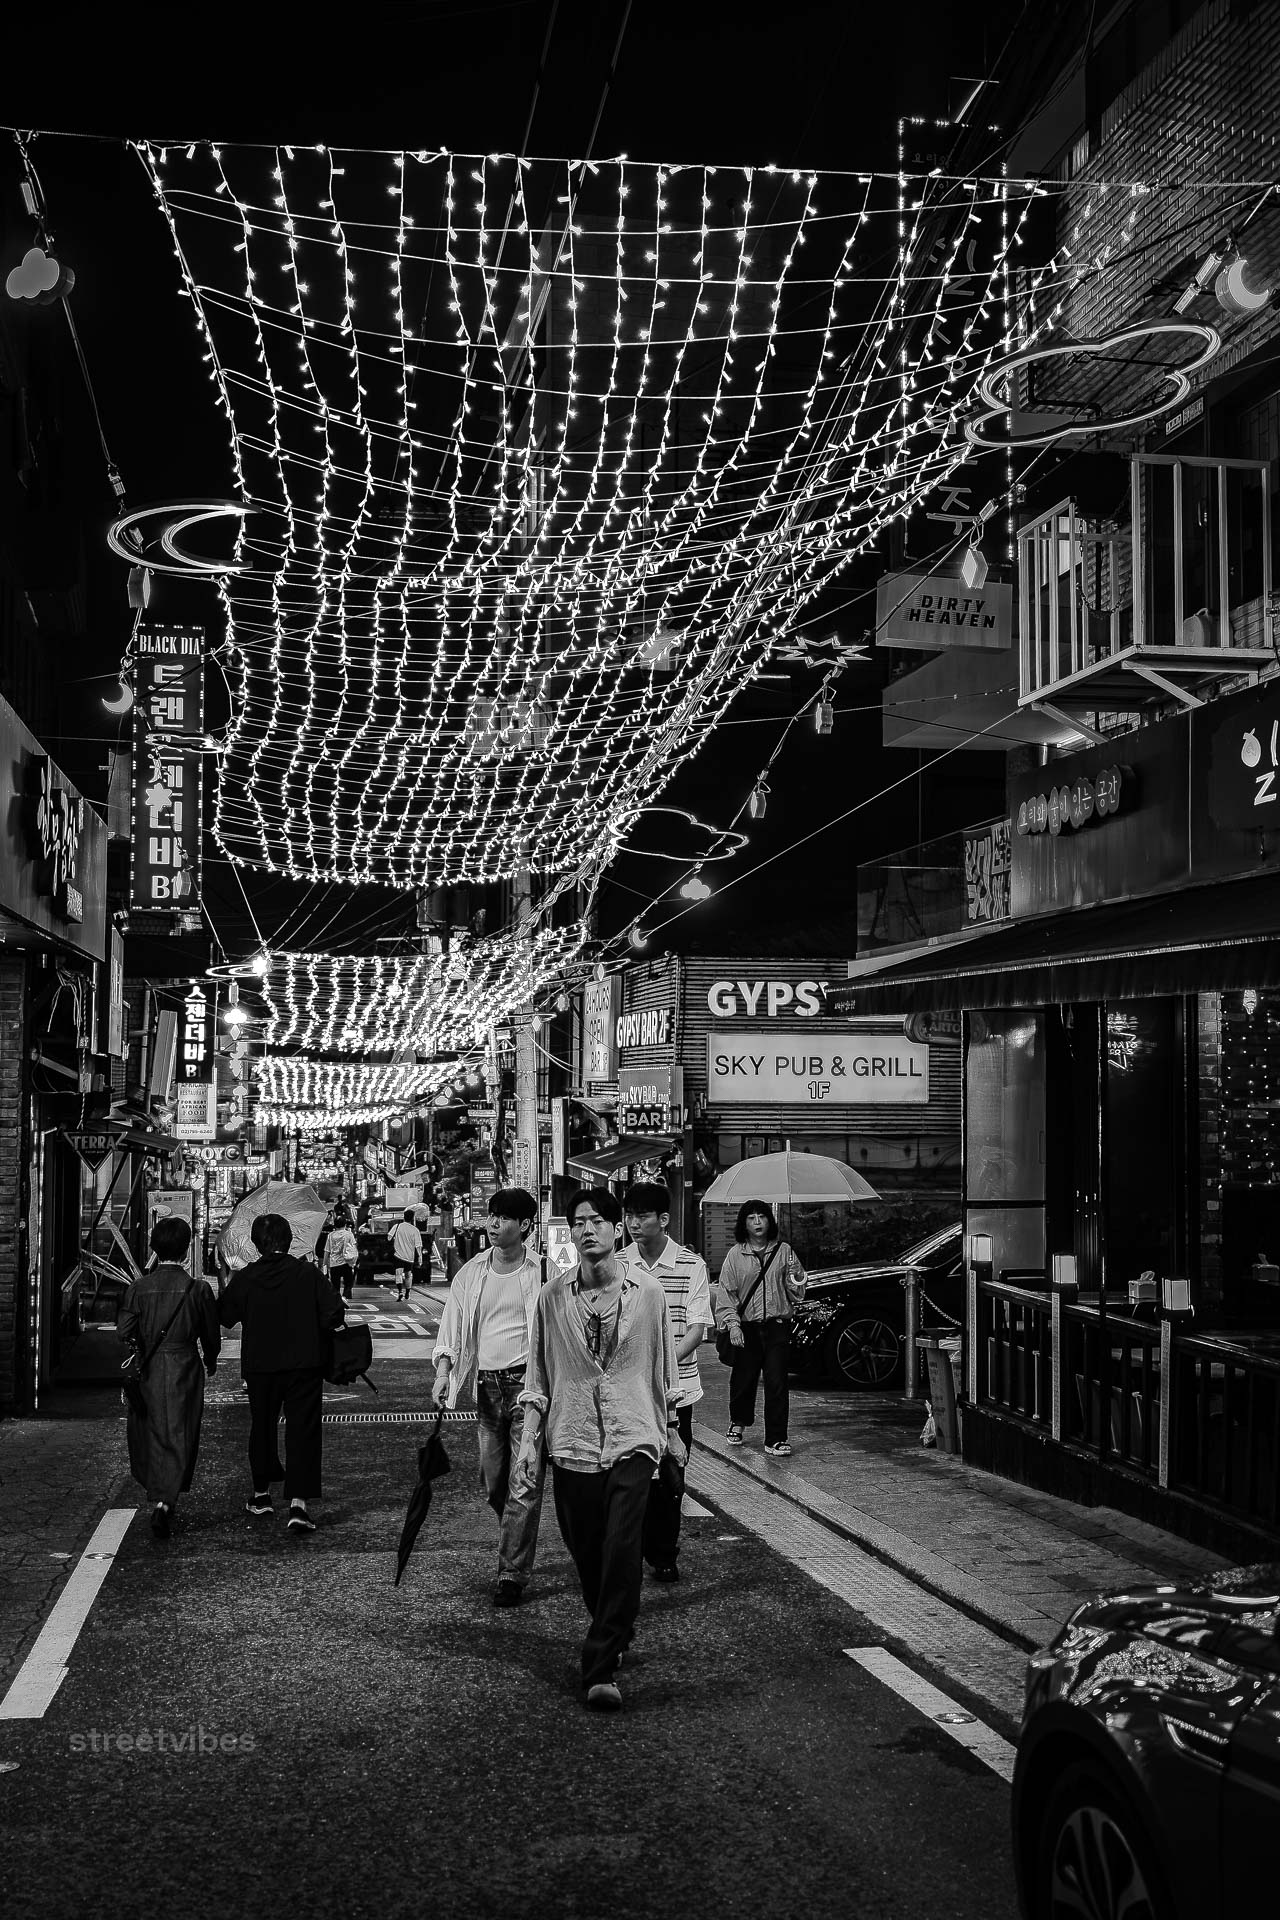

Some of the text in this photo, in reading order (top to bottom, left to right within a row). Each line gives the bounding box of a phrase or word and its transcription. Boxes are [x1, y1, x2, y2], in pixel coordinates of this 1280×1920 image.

[921, 594, 985, 612] DIRTY
[908, 608, 996, 629] HEAVEN
[139, 635, 200, 655] BLACK DIA
[1072, 786, 1092, 819] 있는
[1097, 775, 1118, 807] 공간
[707, 980, 828, 1017] GYPS
[589, 1017, 604, 1045] OPEN
[616, 1009, 669, 1048] GYPSY BAR 2F
[714, 1055, 922, 1077] SKY PUB & GRILL
[808, 1080, 830, 1099] 1F
[627, 1112, 662, 1126] BAR
[70, 1135, 118, 1151] TERRA
